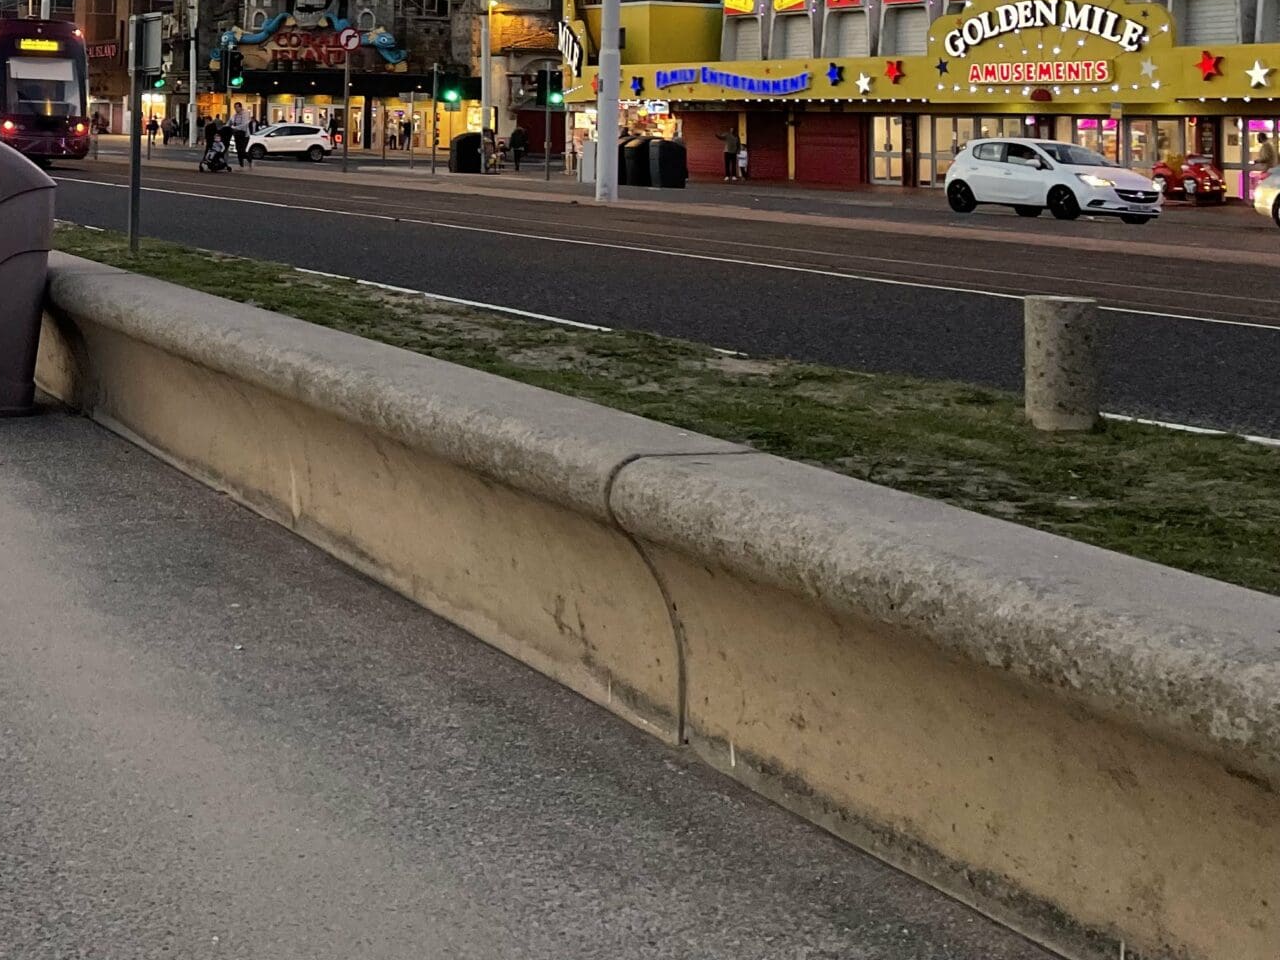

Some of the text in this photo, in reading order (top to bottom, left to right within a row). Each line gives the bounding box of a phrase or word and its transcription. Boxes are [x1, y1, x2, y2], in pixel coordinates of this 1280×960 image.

[944, 0, 1145, 58] GOLDEN MILE
[271, 47, 346, 67] ISLAND
[656, 66, 808, 95] FAMILY ENTERTAINMENT
[968, 60, 1109, 83] AMUSEMENTS
